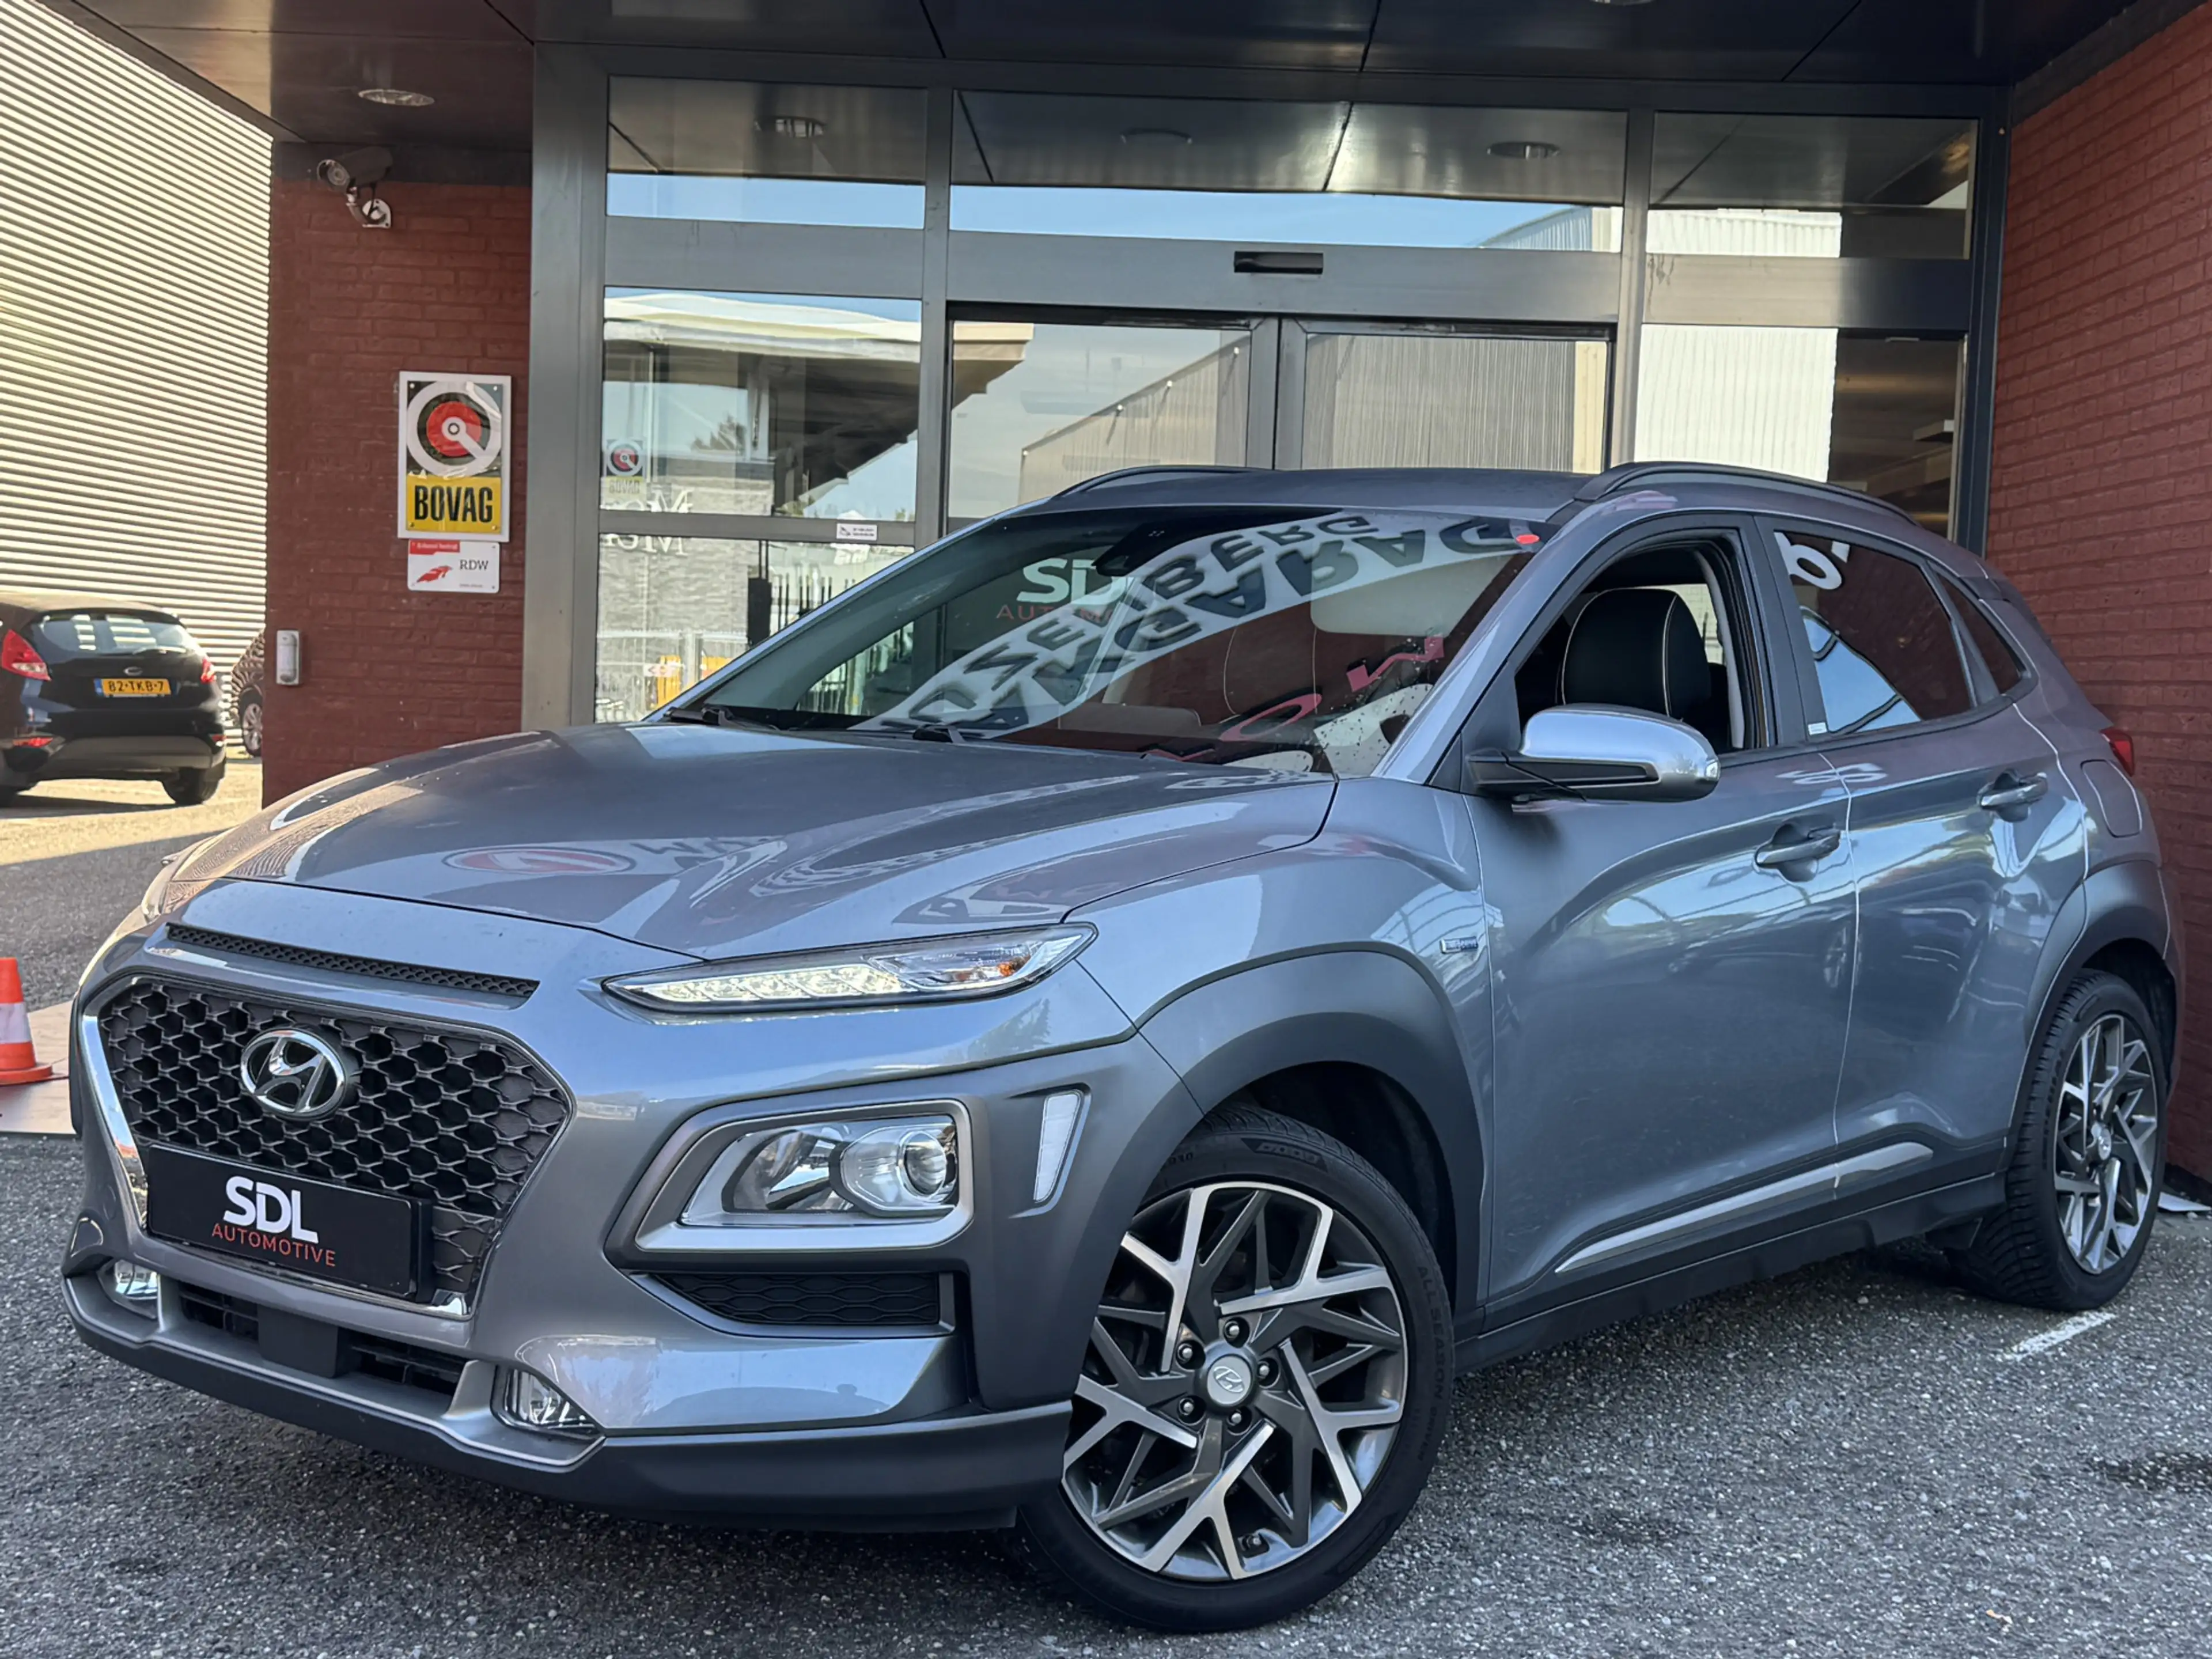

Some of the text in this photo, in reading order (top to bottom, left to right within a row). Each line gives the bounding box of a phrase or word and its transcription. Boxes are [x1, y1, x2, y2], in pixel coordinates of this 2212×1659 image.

[414, 484, 494, 524] BOVAG
[459, 559, 489, 571] RDW
[108, 680, 164, 692] 82-TKB-7
[222, 1175, 319, 1244] SDL
[211, 1222, 336, 1267] AUTOMOTIVE
